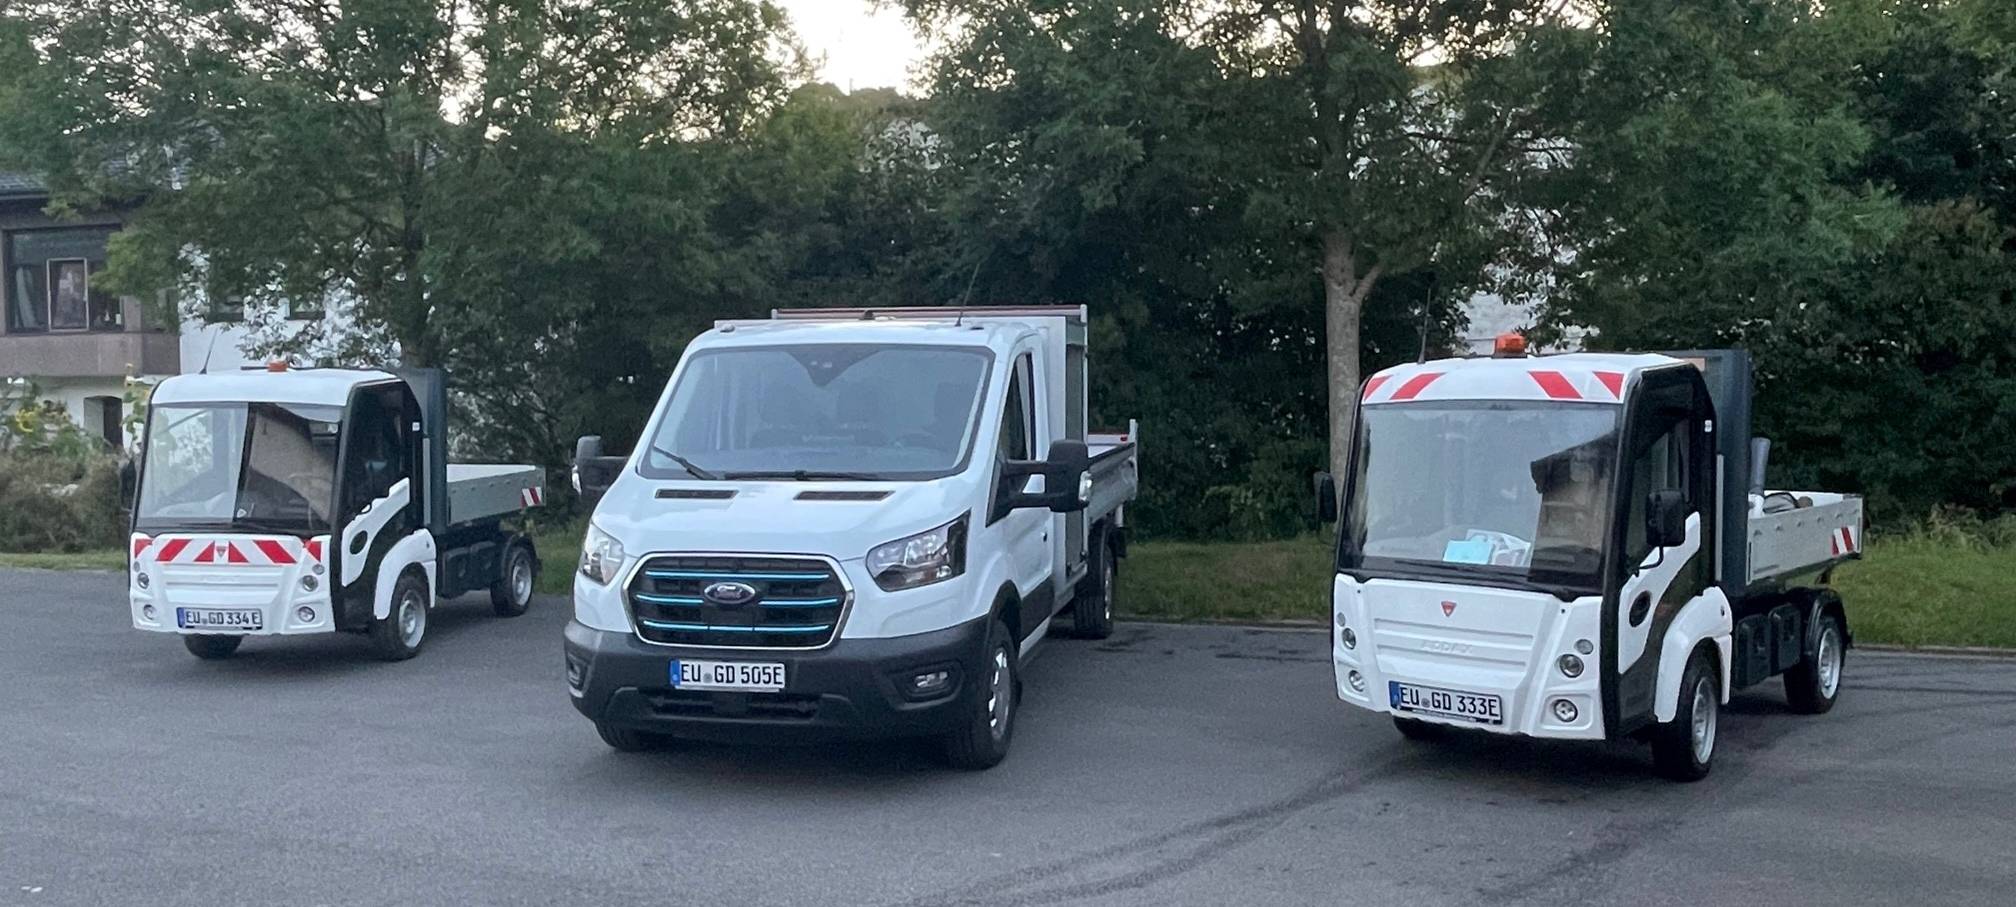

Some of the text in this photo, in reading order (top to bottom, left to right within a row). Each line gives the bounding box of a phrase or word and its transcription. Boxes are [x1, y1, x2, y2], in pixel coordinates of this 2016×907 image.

[185, 611, 201, 624] EU
[208, 612, 224, 624] GD
[680, 664, 783, 685] EU GD 505E
[1400, 687, 1420, 705] EU
[1431, 692, 1452, 710] GD
[1456, 695, 1499, 717] 333E
